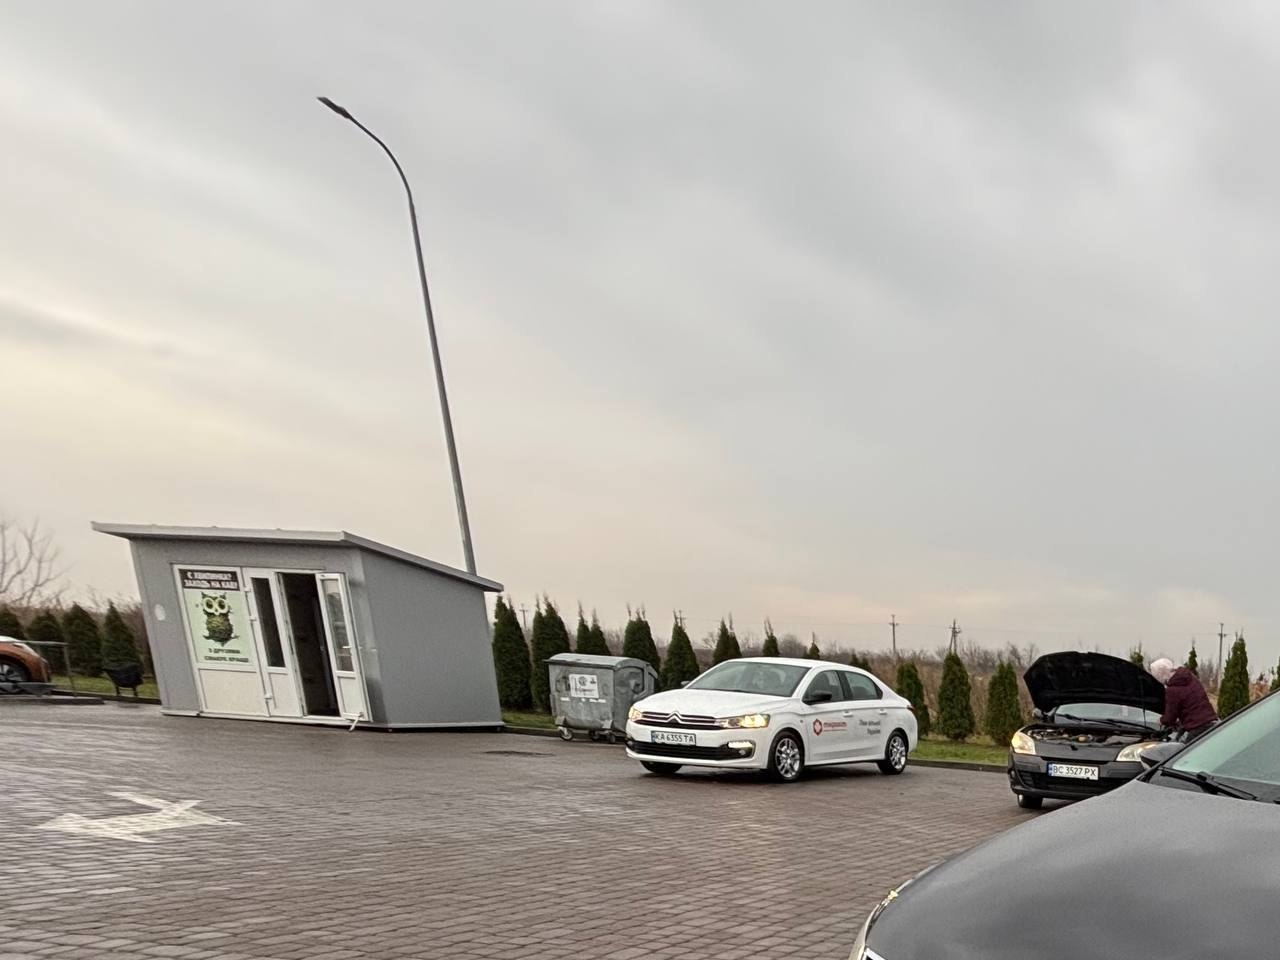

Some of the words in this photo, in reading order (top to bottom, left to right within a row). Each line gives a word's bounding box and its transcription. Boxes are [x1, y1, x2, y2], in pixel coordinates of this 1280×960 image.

[1053, 765, 1065, 774] BC
[1066, 766, 1083, 776] 3527
[1084, 768, 1097, 777] PX
